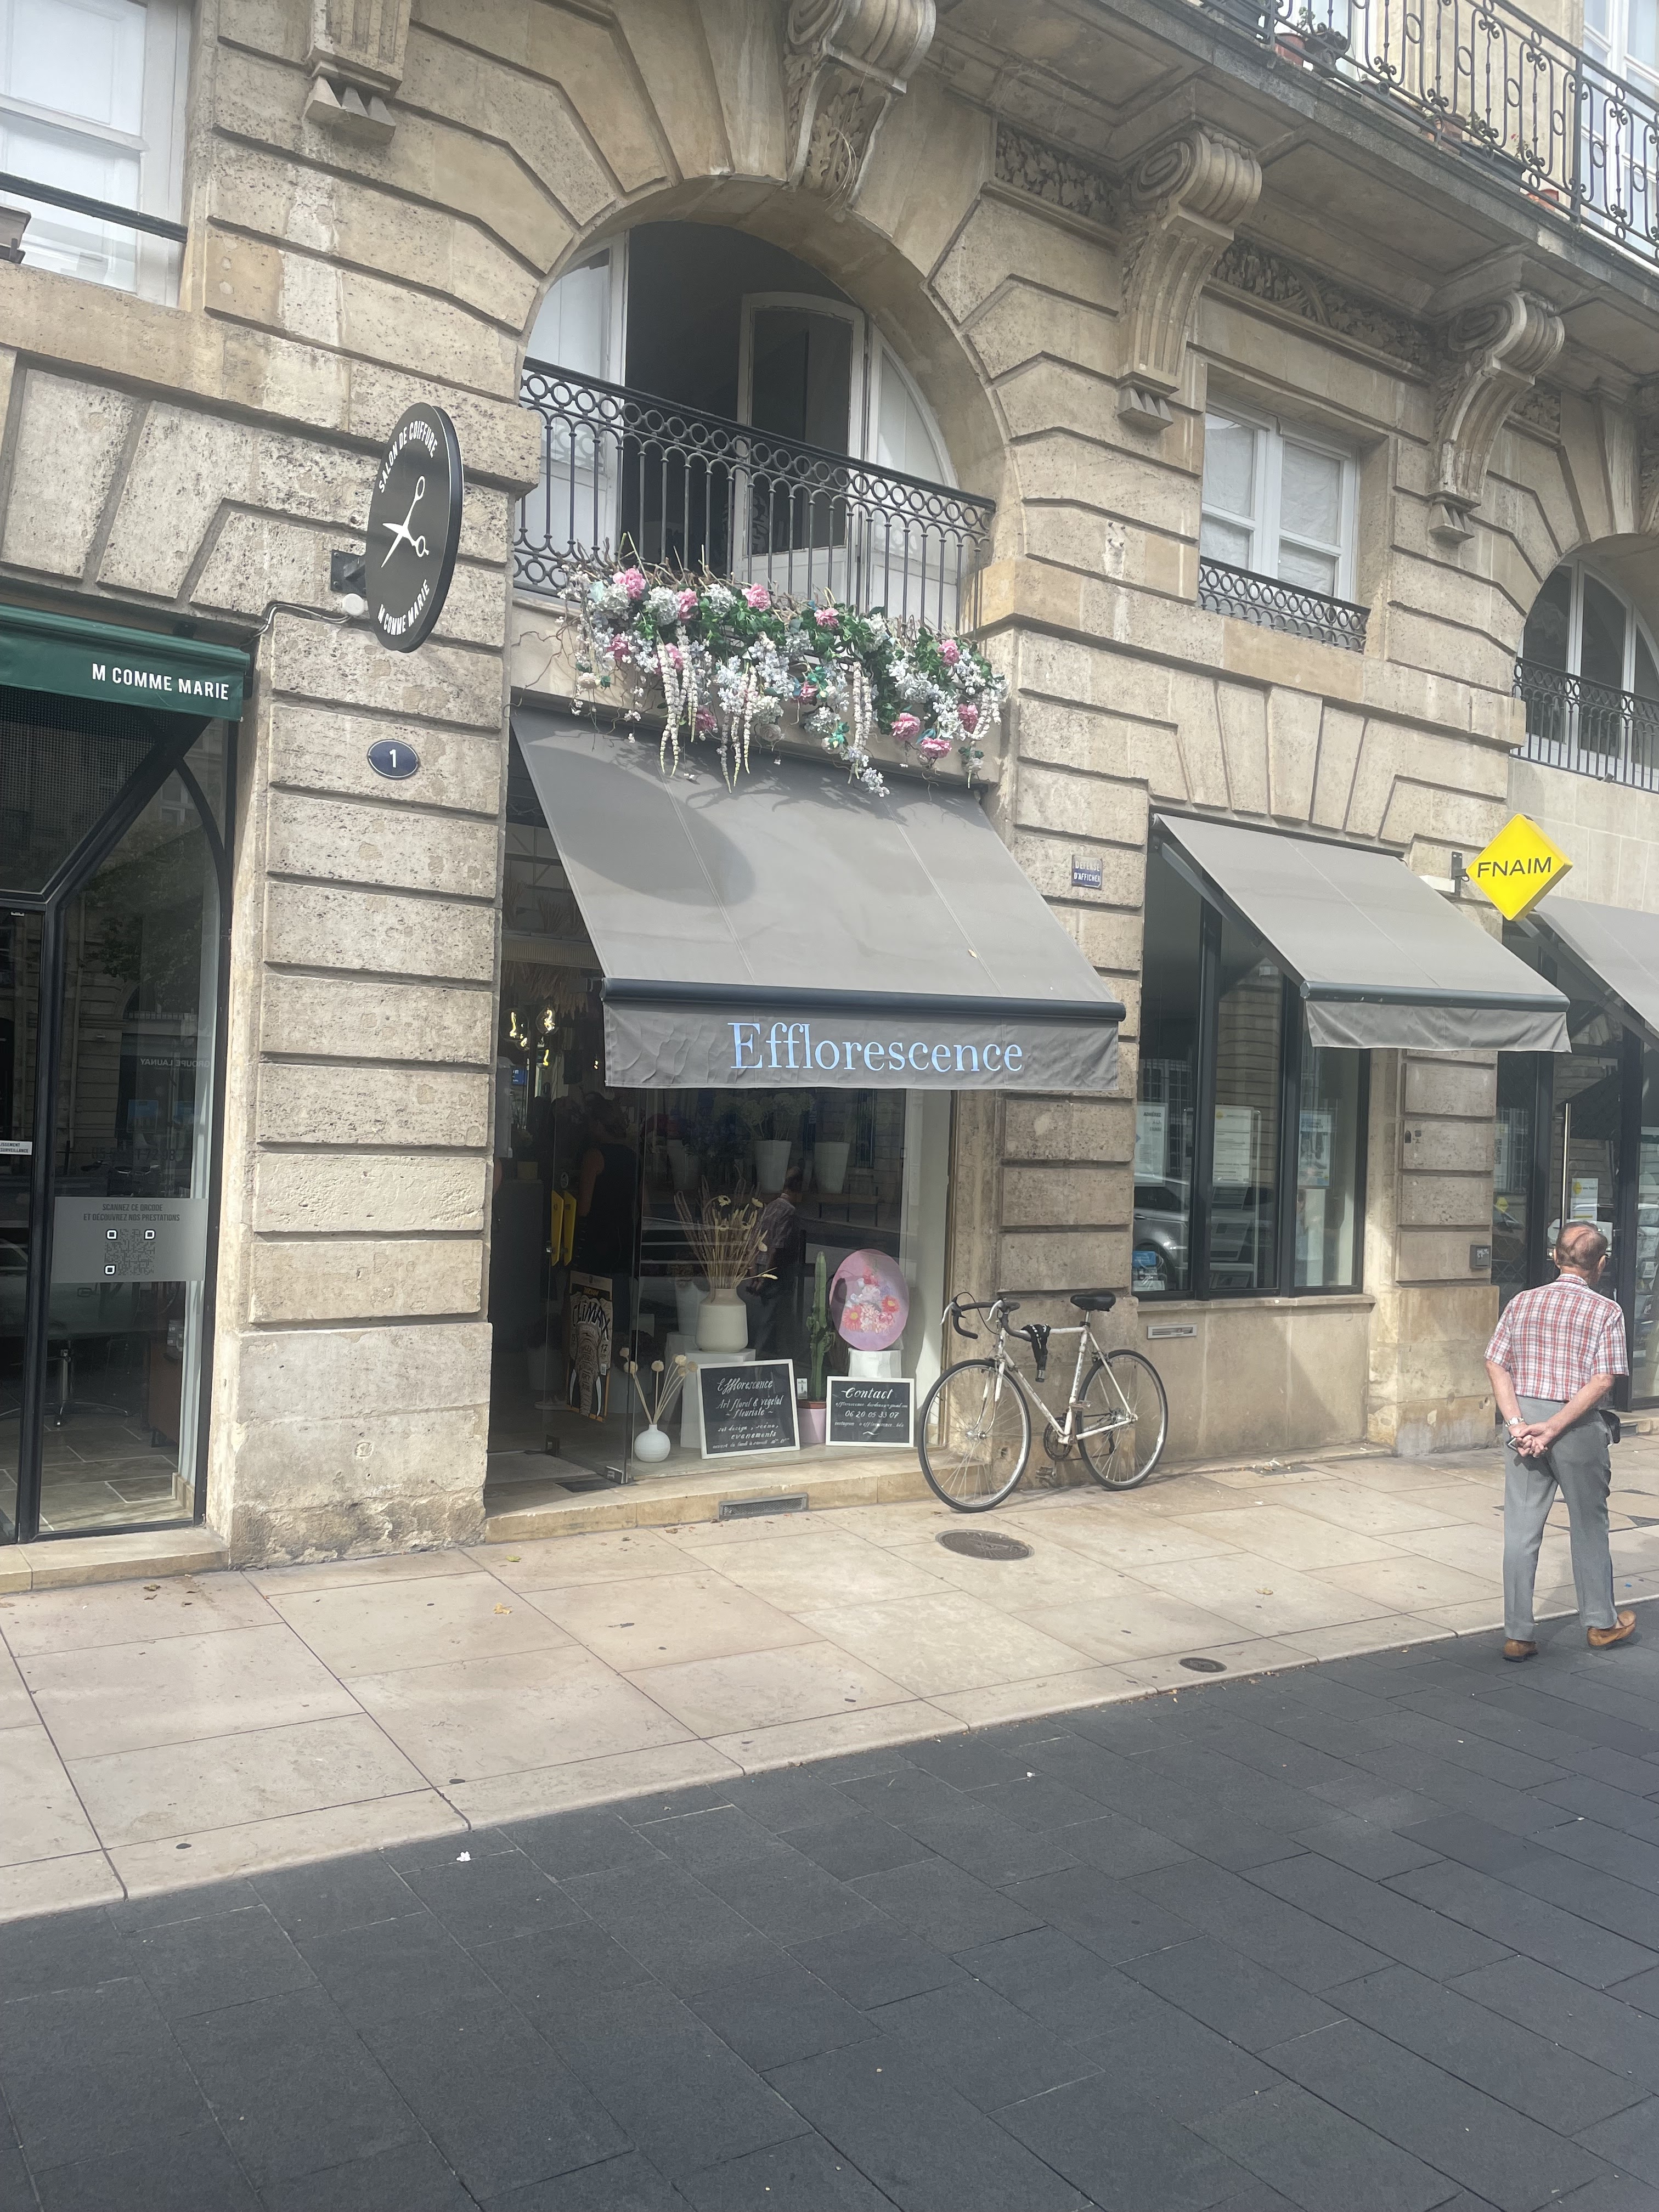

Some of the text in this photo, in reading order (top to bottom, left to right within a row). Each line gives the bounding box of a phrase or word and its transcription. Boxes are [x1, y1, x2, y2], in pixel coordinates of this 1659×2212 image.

[379, 420, 438, 493] SALON DE COIFFURE
[377, 579, 430, 635] M COMME MARIE
[92, 663, 230, 701] M COMME MARIE
[389, 749, 397, 768] 1
[1477, 856, 1552, 878] FNAIM
[727, 1021, 1024, 1073] Efflorescence
[83, 1213, 91, 1221] ET
[92, 1212, 127, 1221] DÉCOUVREZ
[142, 1214, 180, 1222] PRESTATIONS
[717, 1377, 773, 1395] Efflorescence
[840, 1387, 894, 1400] Contact
[715, 1398, 731, 1409] Art
[729, 1397, 753, 1412] floral
[732, 1406, 765, 1419] fleuriste
